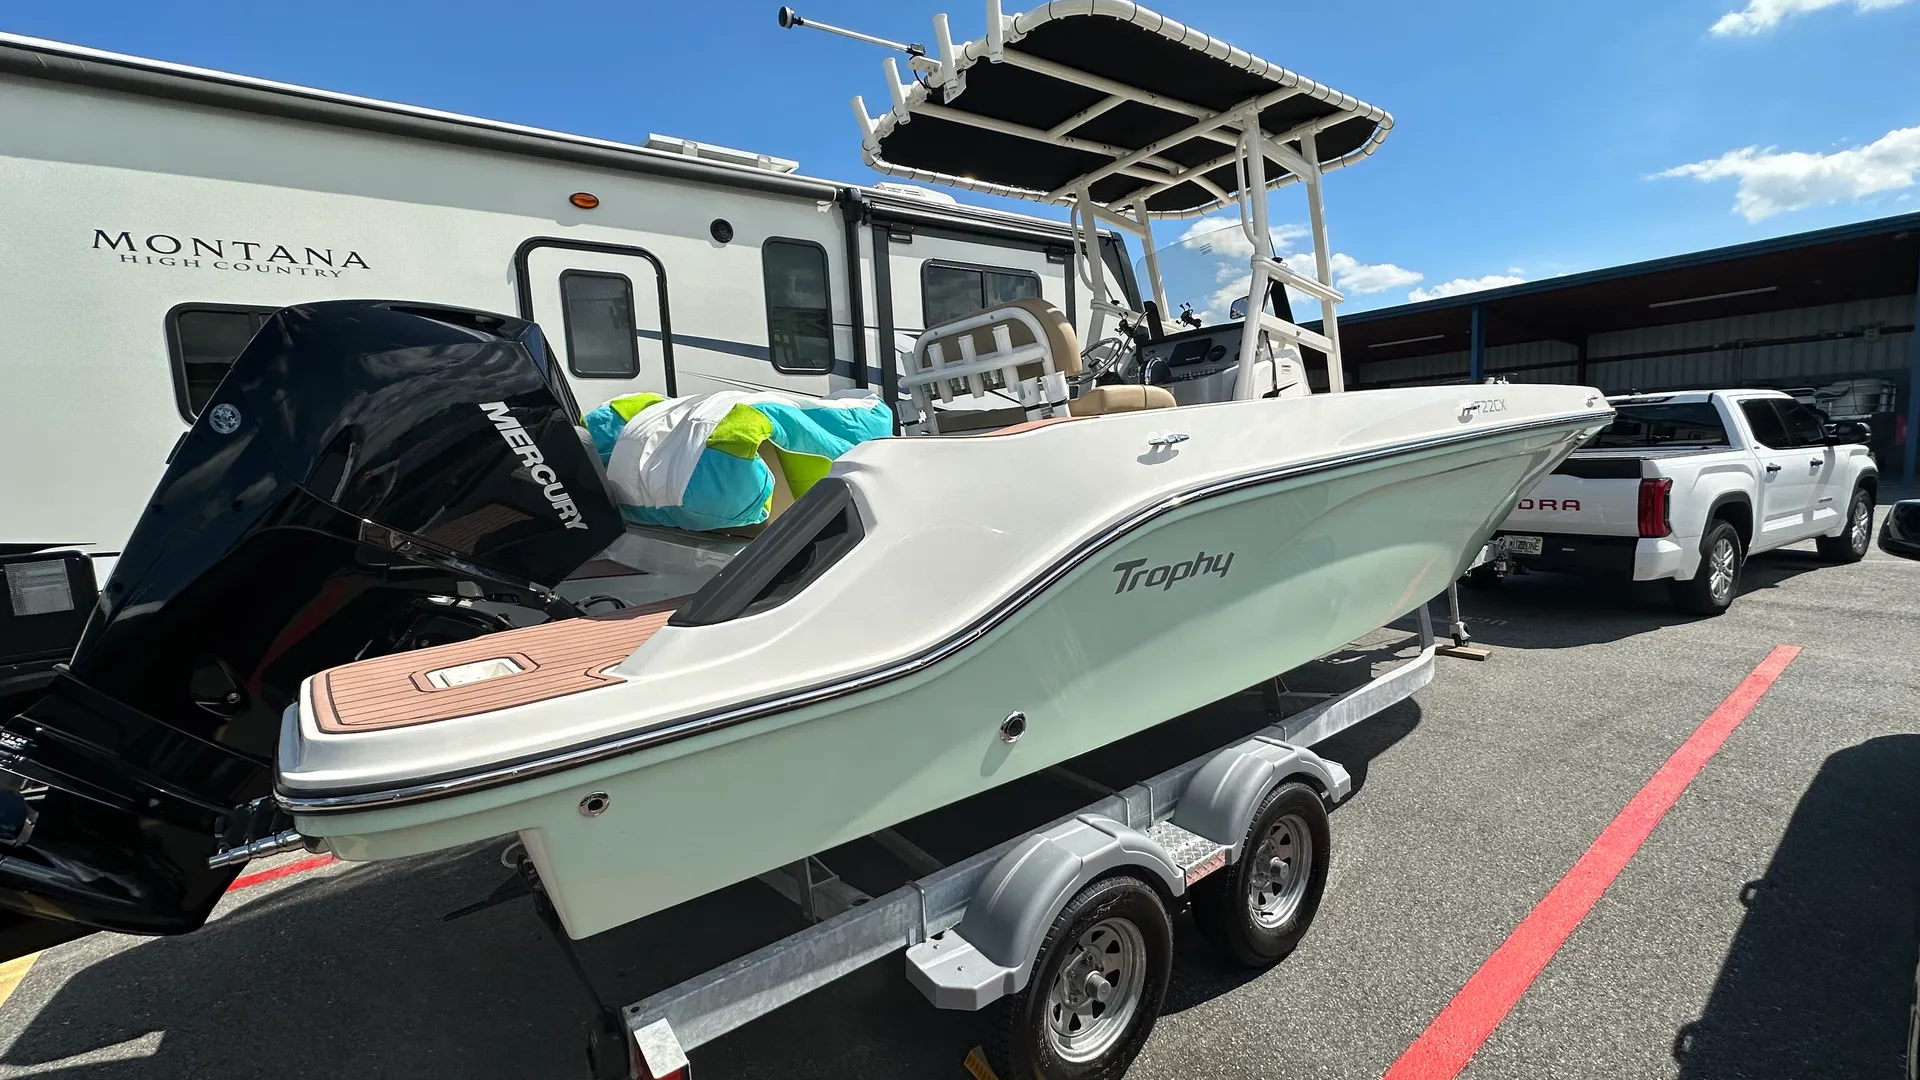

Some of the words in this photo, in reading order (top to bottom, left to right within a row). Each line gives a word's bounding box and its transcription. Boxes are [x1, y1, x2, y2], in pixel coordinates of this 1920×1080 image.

[92, 228, 371, 270] MONTANA
[119, 254, 202, 268] HIGH
[213, 261, 342, 278] COUNTRY
[479, 401, 589, 530] MERCURY
[1112, 551, 1234, 595] Trophy
